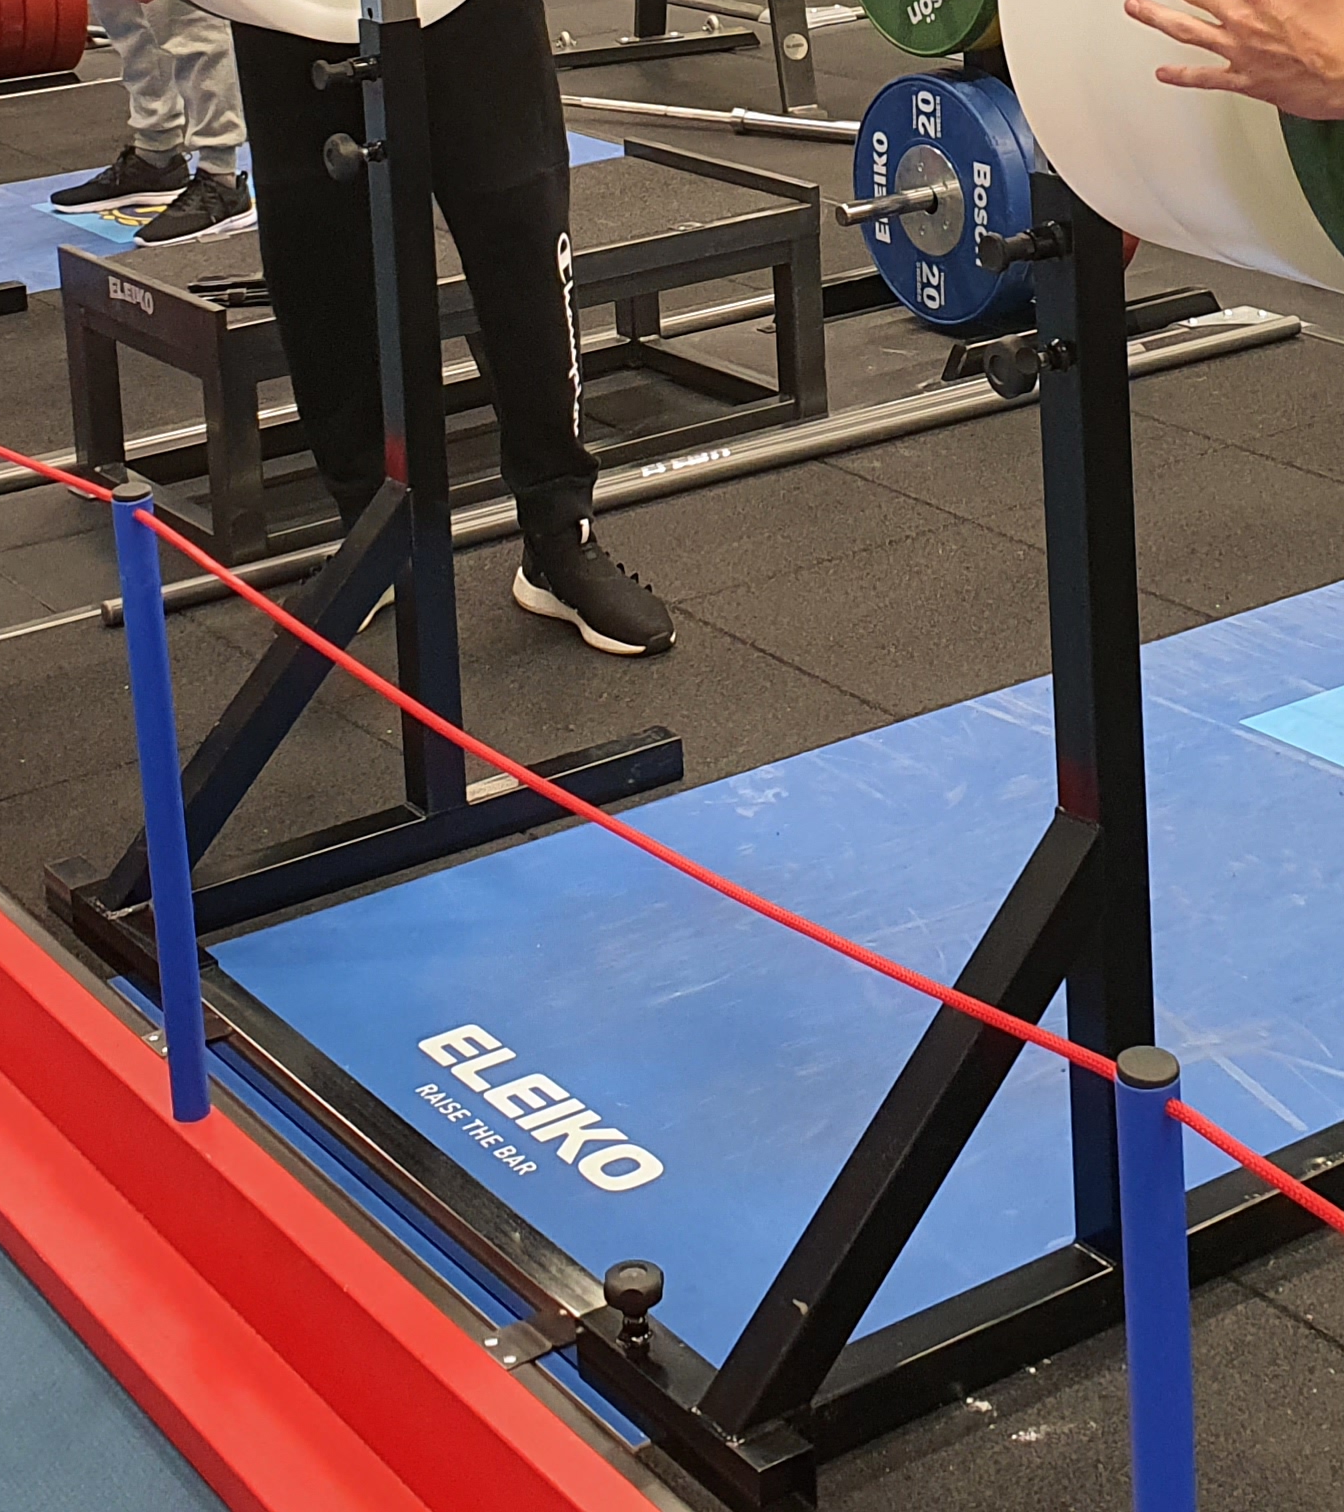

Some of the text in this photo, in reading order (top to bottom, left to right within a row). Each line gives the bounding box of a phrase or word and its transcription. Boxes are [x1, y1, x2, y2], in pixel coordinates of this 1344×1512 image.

[917, 90, 936, 139] 20
[872, 131, 891, 244] EEIKO
[557, 232, 582, 438] Champion
[922, 260, 941, 309] 20
[414, 1083, 537, 1176] RAISE THE BAR
[418, 1023, 664, 1192] ELEIKO
